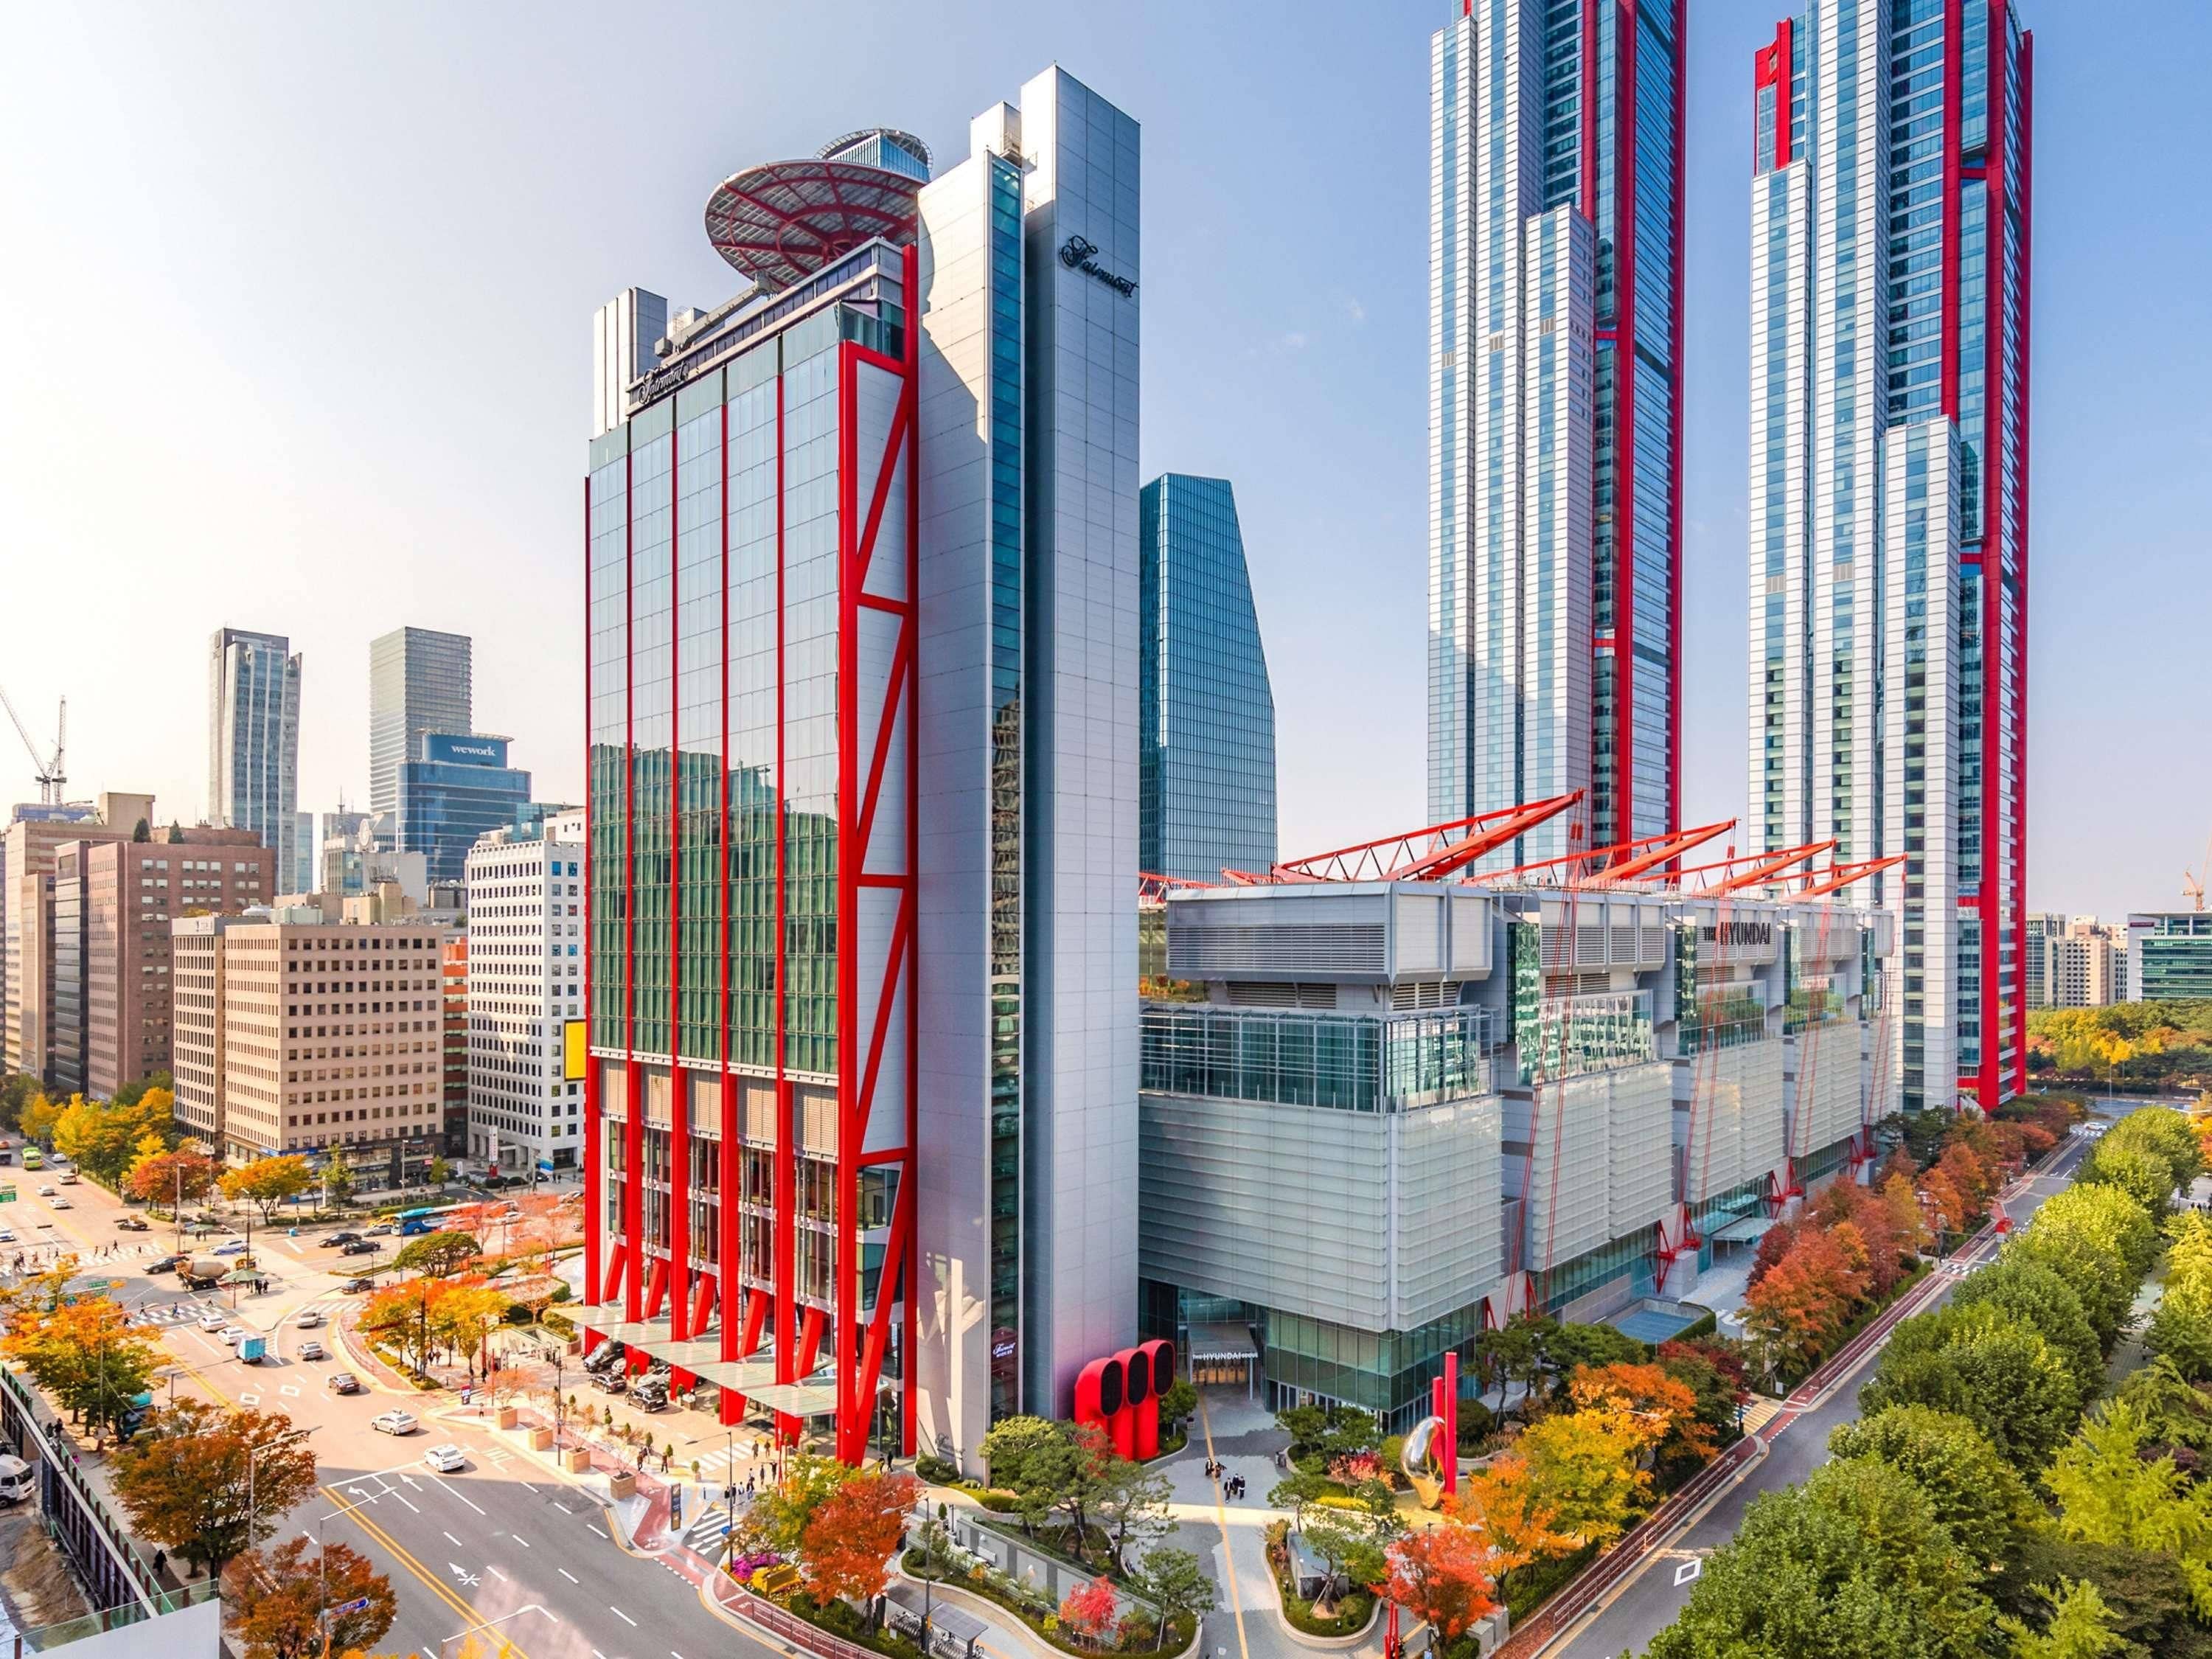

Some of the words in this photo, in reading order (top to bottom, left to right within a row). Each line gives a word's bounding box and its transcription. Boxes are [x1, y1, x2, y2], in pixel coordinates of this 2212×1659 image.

[1062, 234, 1139, 298] Fairmont
[638, 361, 685, 404] Fairmont
[451, 745, 495, 757] wework
[1720, 922, 1770, 945] HYUNDAI
[1203, 1352, 1241, 1360] HYUNDAI
